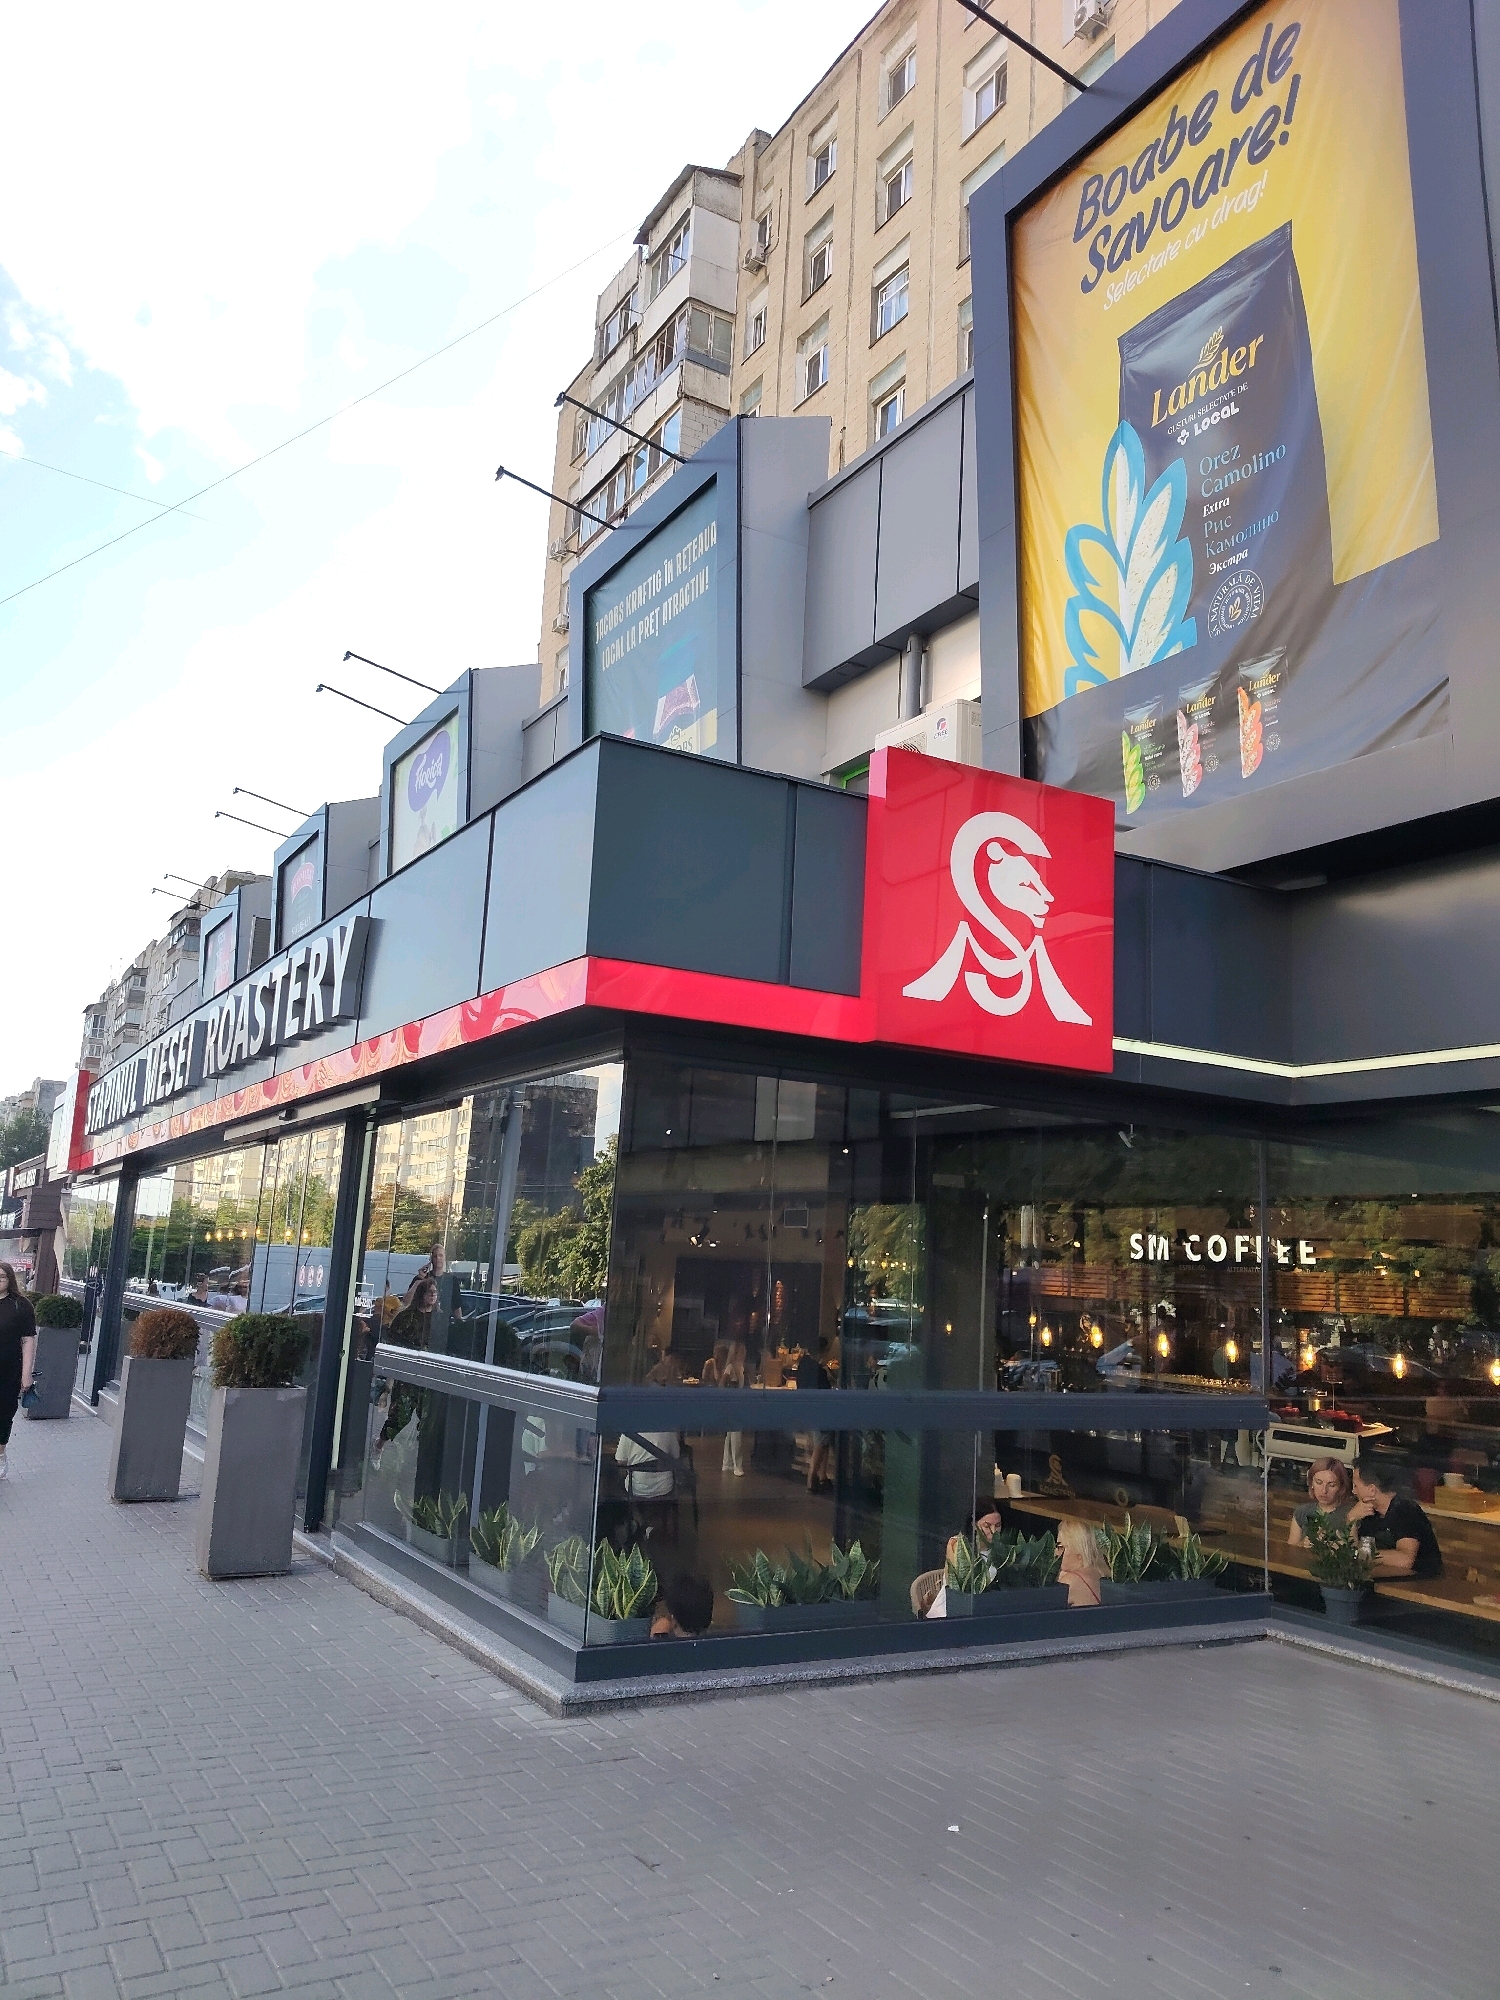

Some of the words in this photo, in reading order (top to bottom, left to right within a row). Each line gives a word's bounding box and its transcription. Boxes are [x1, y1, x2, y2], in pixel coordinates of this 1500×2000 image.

[1073, 90, 1219, 243] Boabe
[1230, 22, 1301, 114] de
[1081, 74, 1301, 294] Savoare!
[1103, 239, 1182, 311] Selectate
[1184, 219, 1208, 250] cu
[1211, 169, 1269, 231] drag!
[1151, 334, 1264, 428] Lander
[1167, 412, 1197, 435] GUSTURI
[1197, 389, 1236, 418] SELECTATE
[1237, 381, 1249, 394] DE
[1199, 444, 1241, 476] Orez
[1201, 444, 1287, 498] Camolino
[1202, 497, 1230, 518] Extra
[1203, 515, 1232, 539] Рис
[1205, 510, 1279, 559] Камолино
[1208, 548, 1249, 575] Экстра
[595, 606, 625, 645] JACOBS
[625, 569, 662, 618] KRAFTIG
[663, 557, 674, 587] ÎN
[602, 641, 625, 672] LOCAL
[626, 624, 637, 651] LA
[637, 606, 660, 645] PREȚ
[662, 565, 710, 627] ATRACTIV!
[1186, 695, 1217, 714] Lander
[1248, 672, 1281, 692] Lander
[1130, 718, 1157, 735] Lander
[142, 1020, 198, 1107] MESEI
[203, 916, 364, 1079] ROASTERY
[1129, 1233, 1170, 1261] SM
